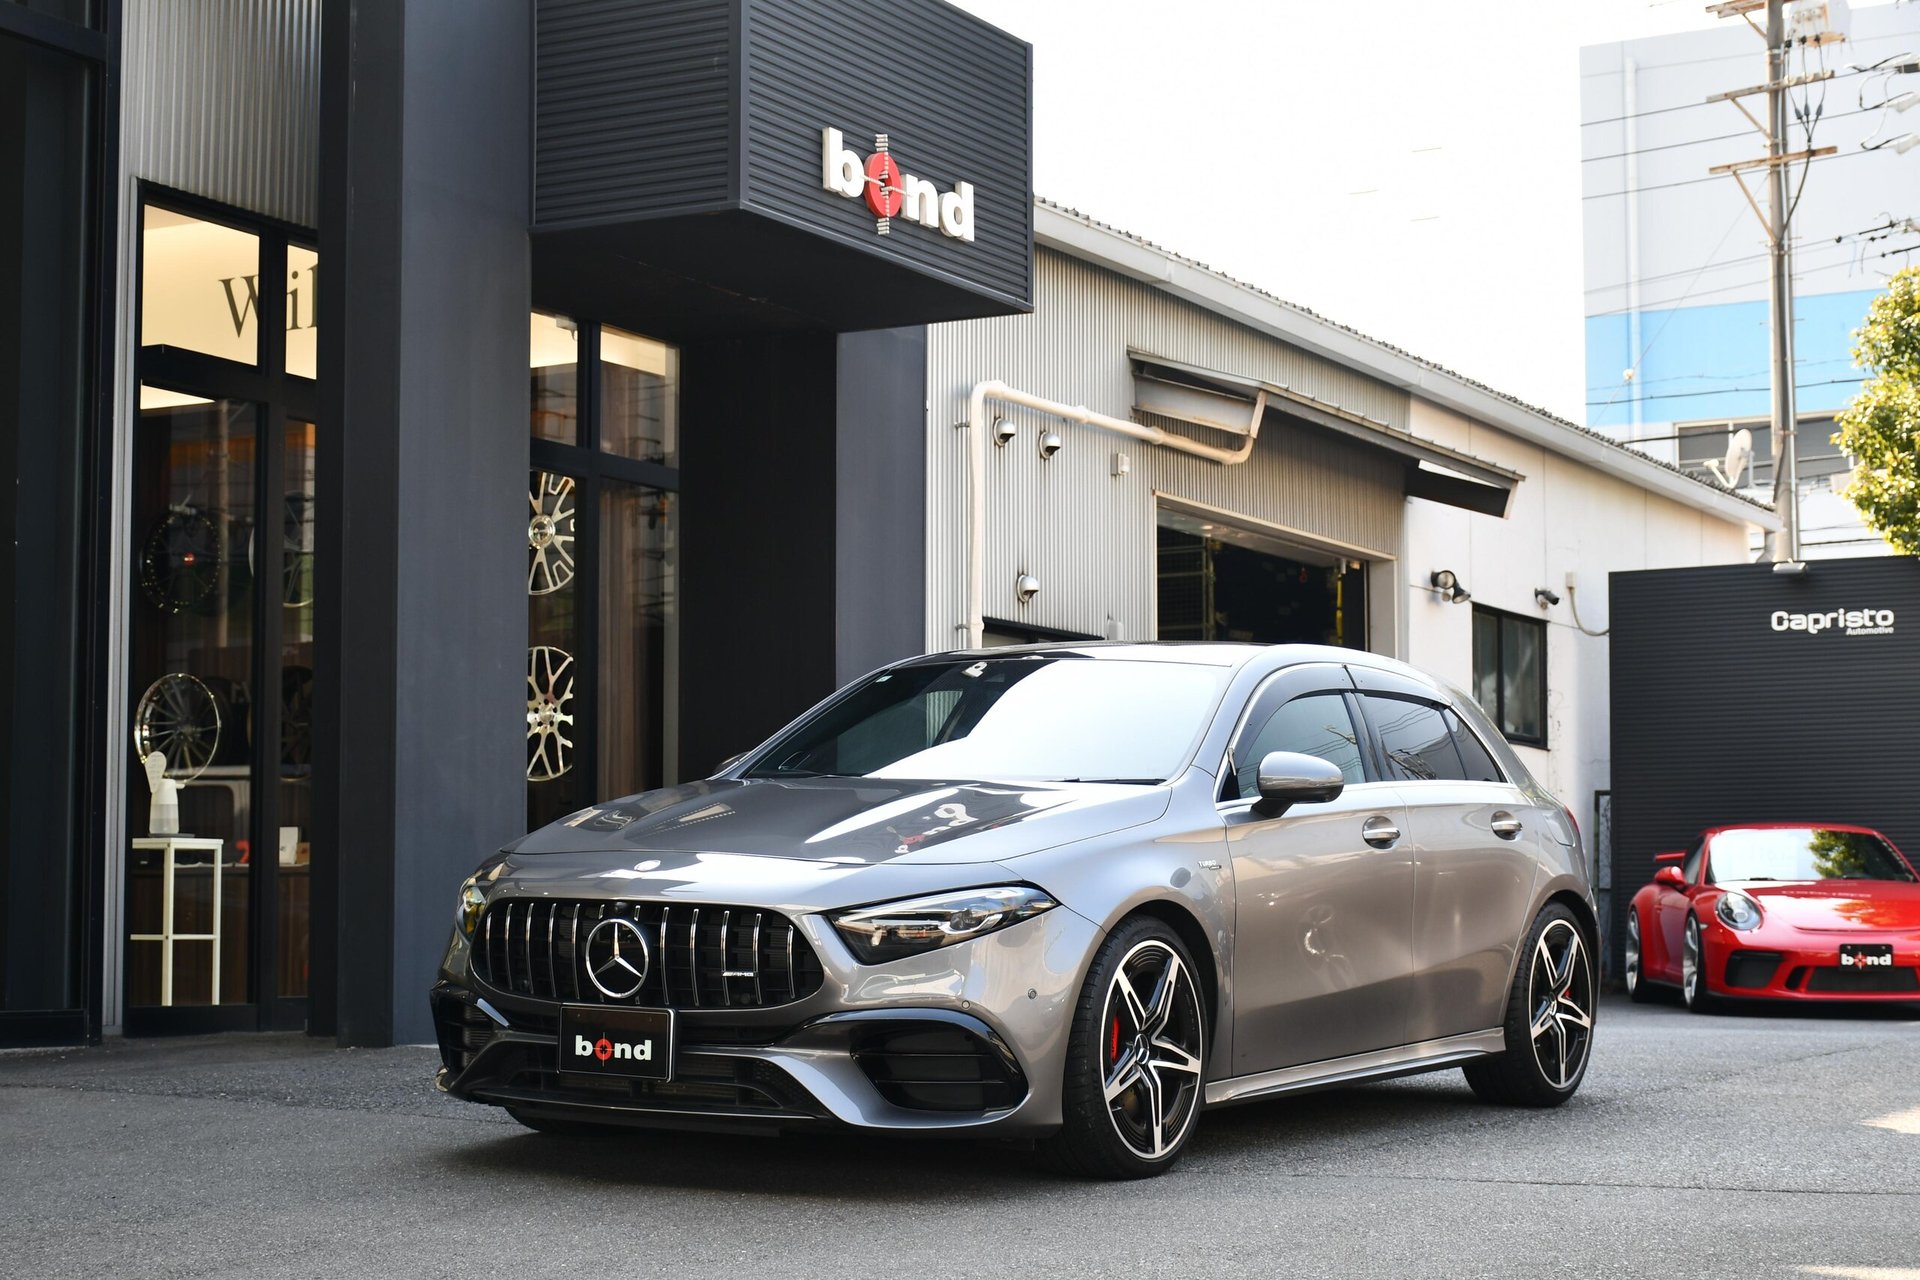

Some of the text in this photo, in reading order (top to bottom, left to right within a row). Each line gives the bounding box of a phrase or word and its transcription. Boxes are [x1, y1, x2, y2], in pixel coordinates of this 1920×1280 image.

[822, 127, 975, 242] bond
[1771, 608, 1895, 634] Capristo
[1845, 627, 1894, 636] Automotive
[1841, 953, 1892, 966] bond
[575, 1034, 652, 1061] bond
